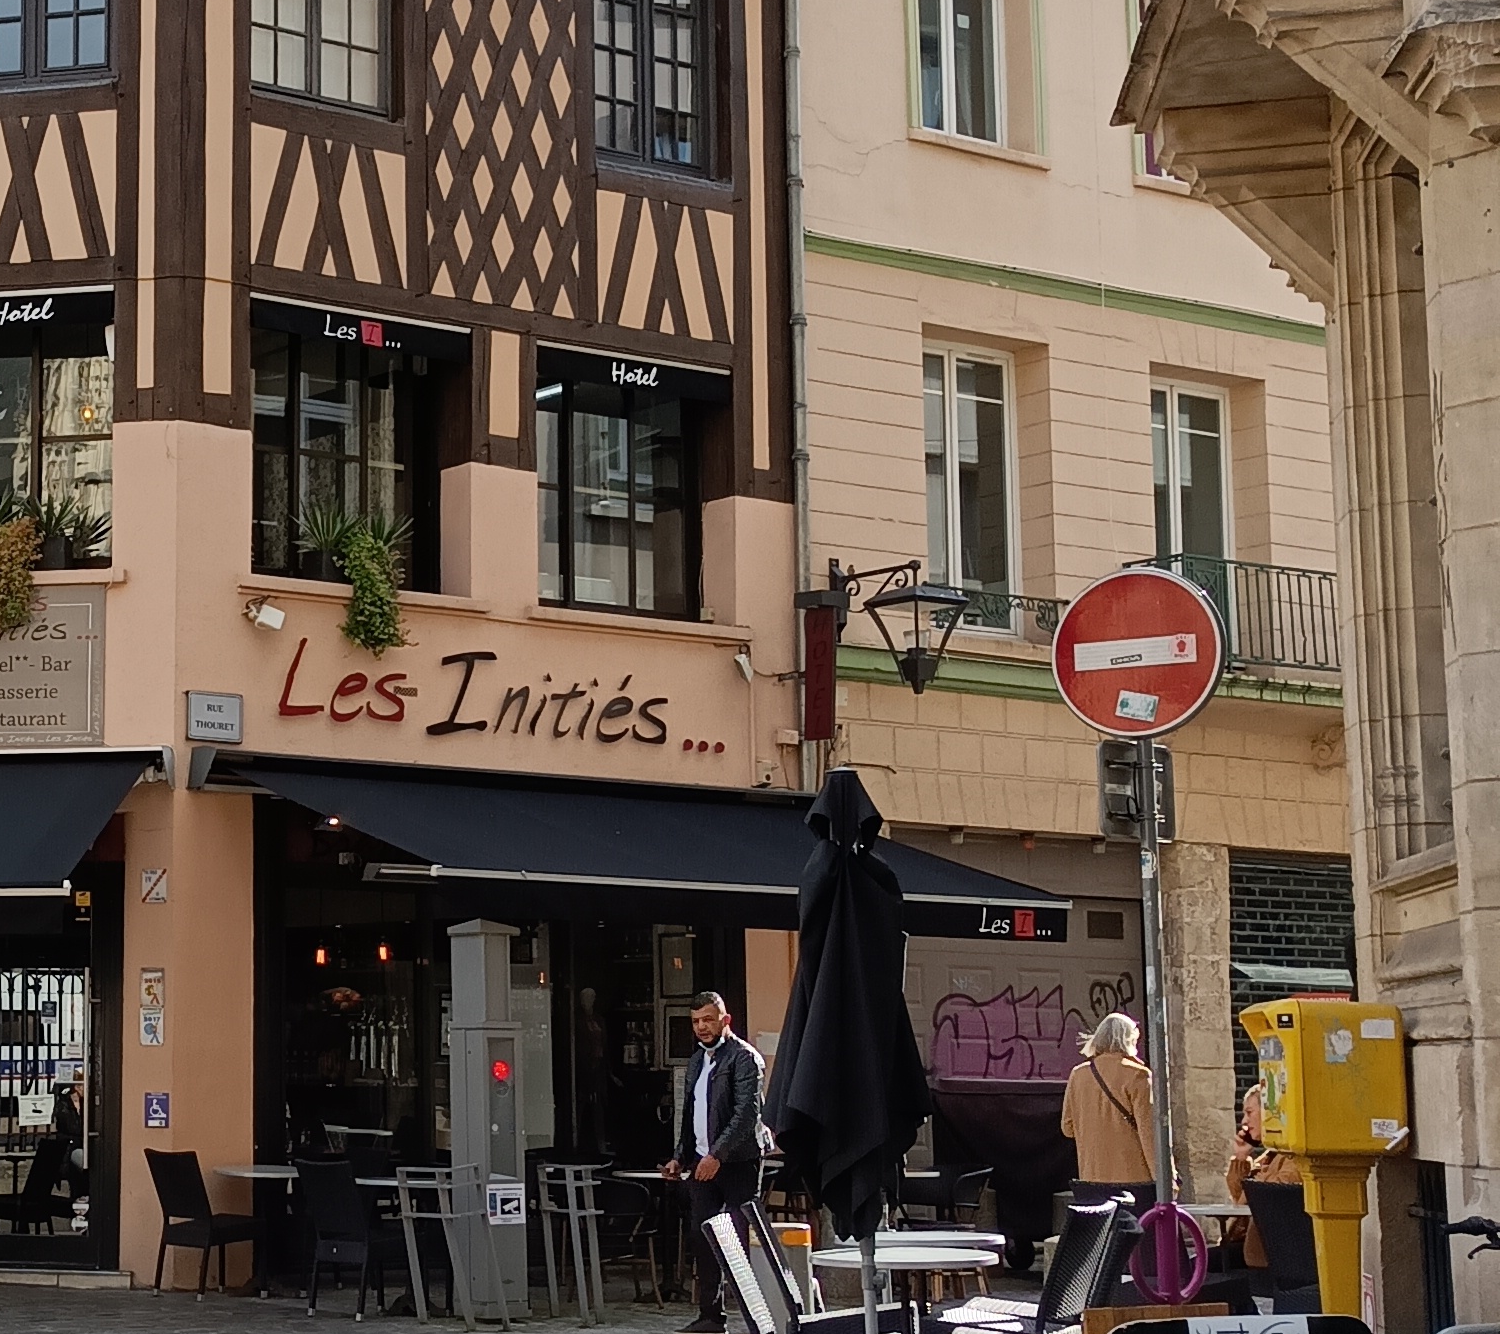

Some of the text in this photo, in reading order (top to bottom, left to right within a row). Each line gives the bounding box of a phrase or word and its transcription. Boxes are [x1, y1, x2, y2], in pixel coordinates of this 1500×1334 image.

[323, 315, 357, 340] Les
[611, 362, 659, 387] Hotel
[41, 655, 72, 672] Bar
[277, 636, 408, 723] Les
[206, 703, 225, 714] RUE
[194, 719, 236, 732] THOURET
[978, 906, 1011, 935] Les
